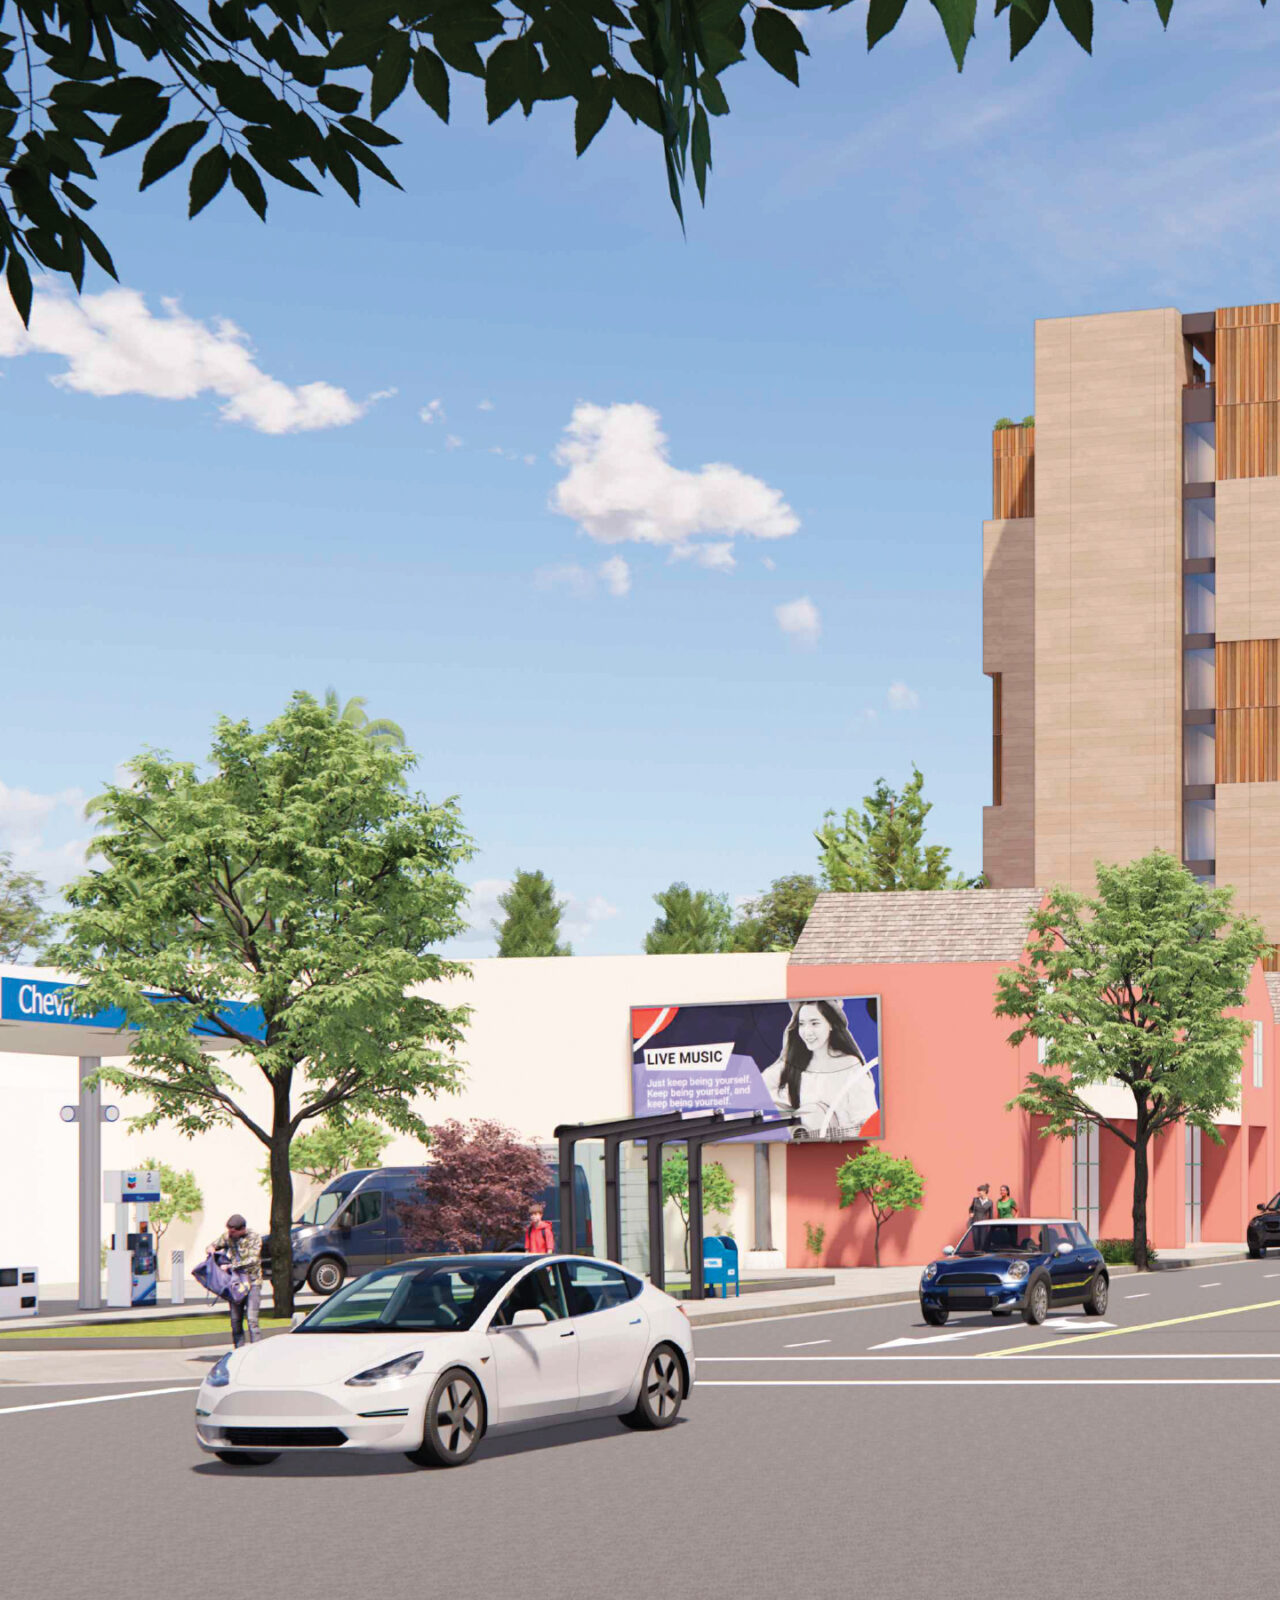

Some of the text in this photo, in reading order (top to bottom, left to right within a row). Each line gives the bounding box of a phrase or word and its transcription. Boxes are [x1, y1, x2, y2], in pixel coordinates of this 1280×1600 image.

[647, 1051, 723, 1065] LIVE MUSIC
[647, 1074, 752, 1088] Just keep being yourself.
[647, 1085, 750, 1099] Keep being yourself, and
[647, 1099, 668, 1109] keep
[669, 1098, 693, 1108] being
[146, 1172, 152, 1183] 2
